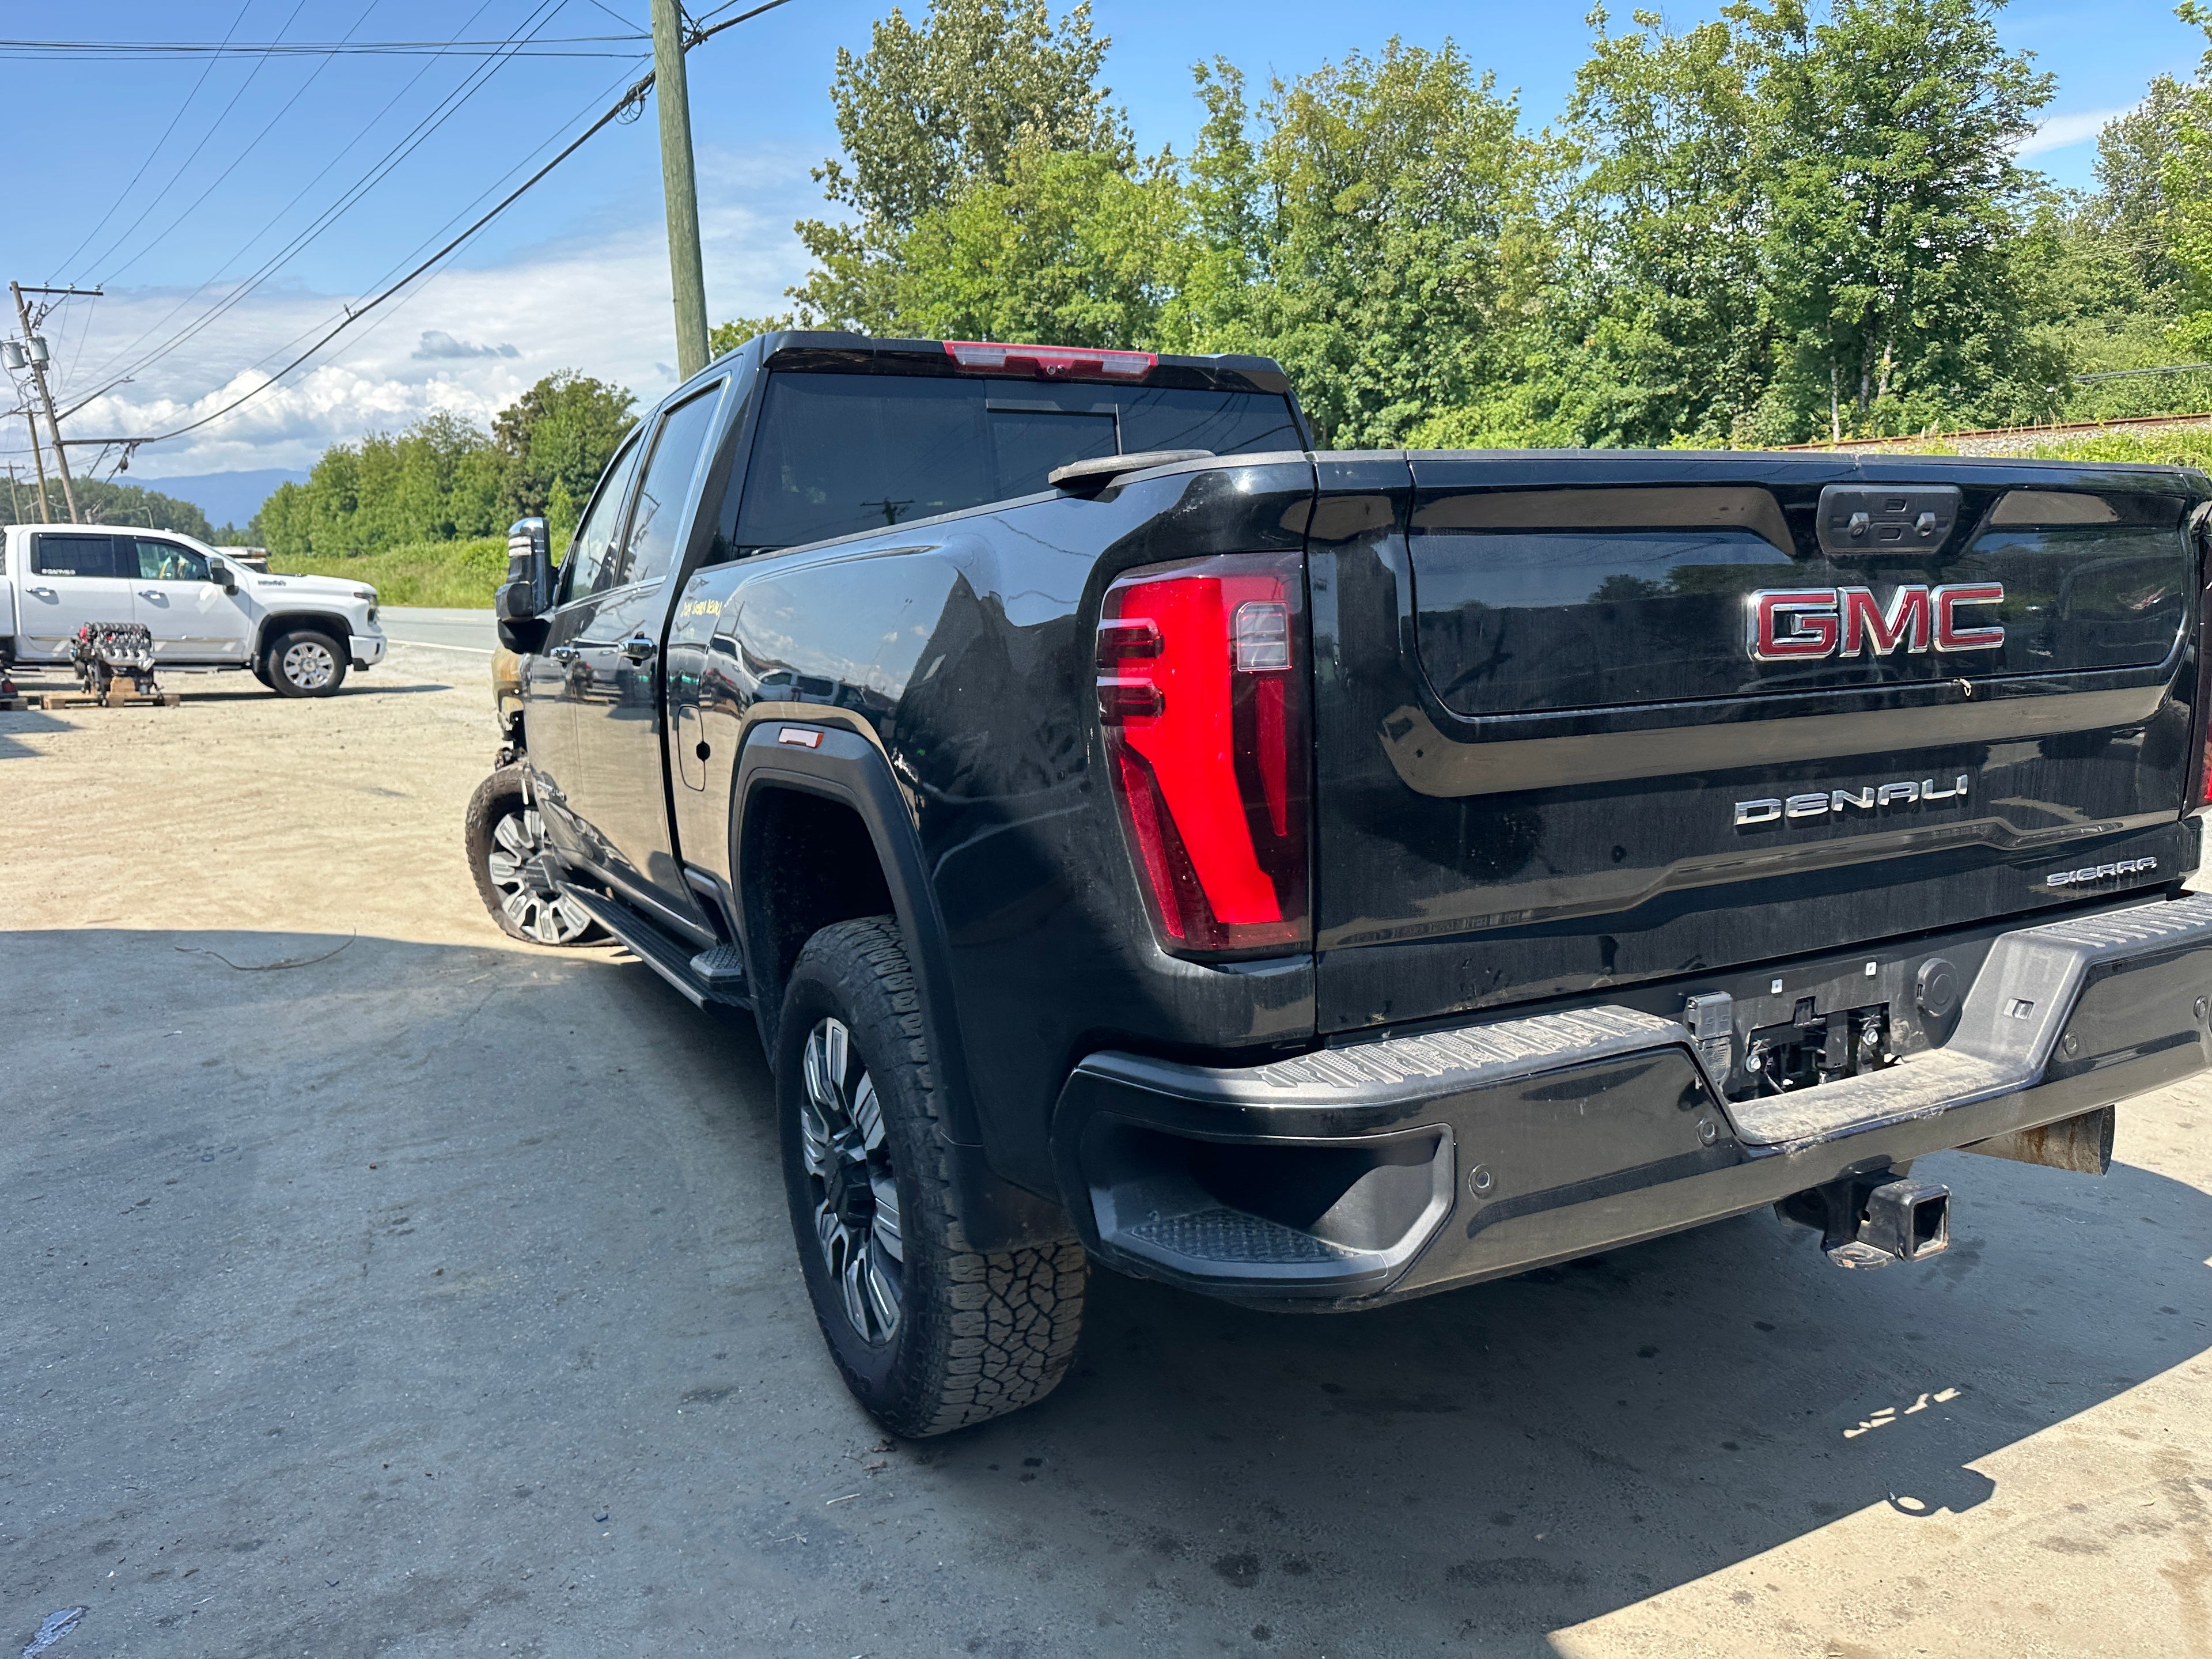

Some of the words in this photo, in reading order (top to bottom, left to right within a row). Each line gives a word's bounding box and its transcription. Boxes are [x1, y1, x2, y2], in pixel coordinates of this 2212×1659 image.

[1747, 582, 2005, 661] GMC
[1734, 774, 1968, 825] DENALI
[2046, 856, 2157, 887] SIERRA
